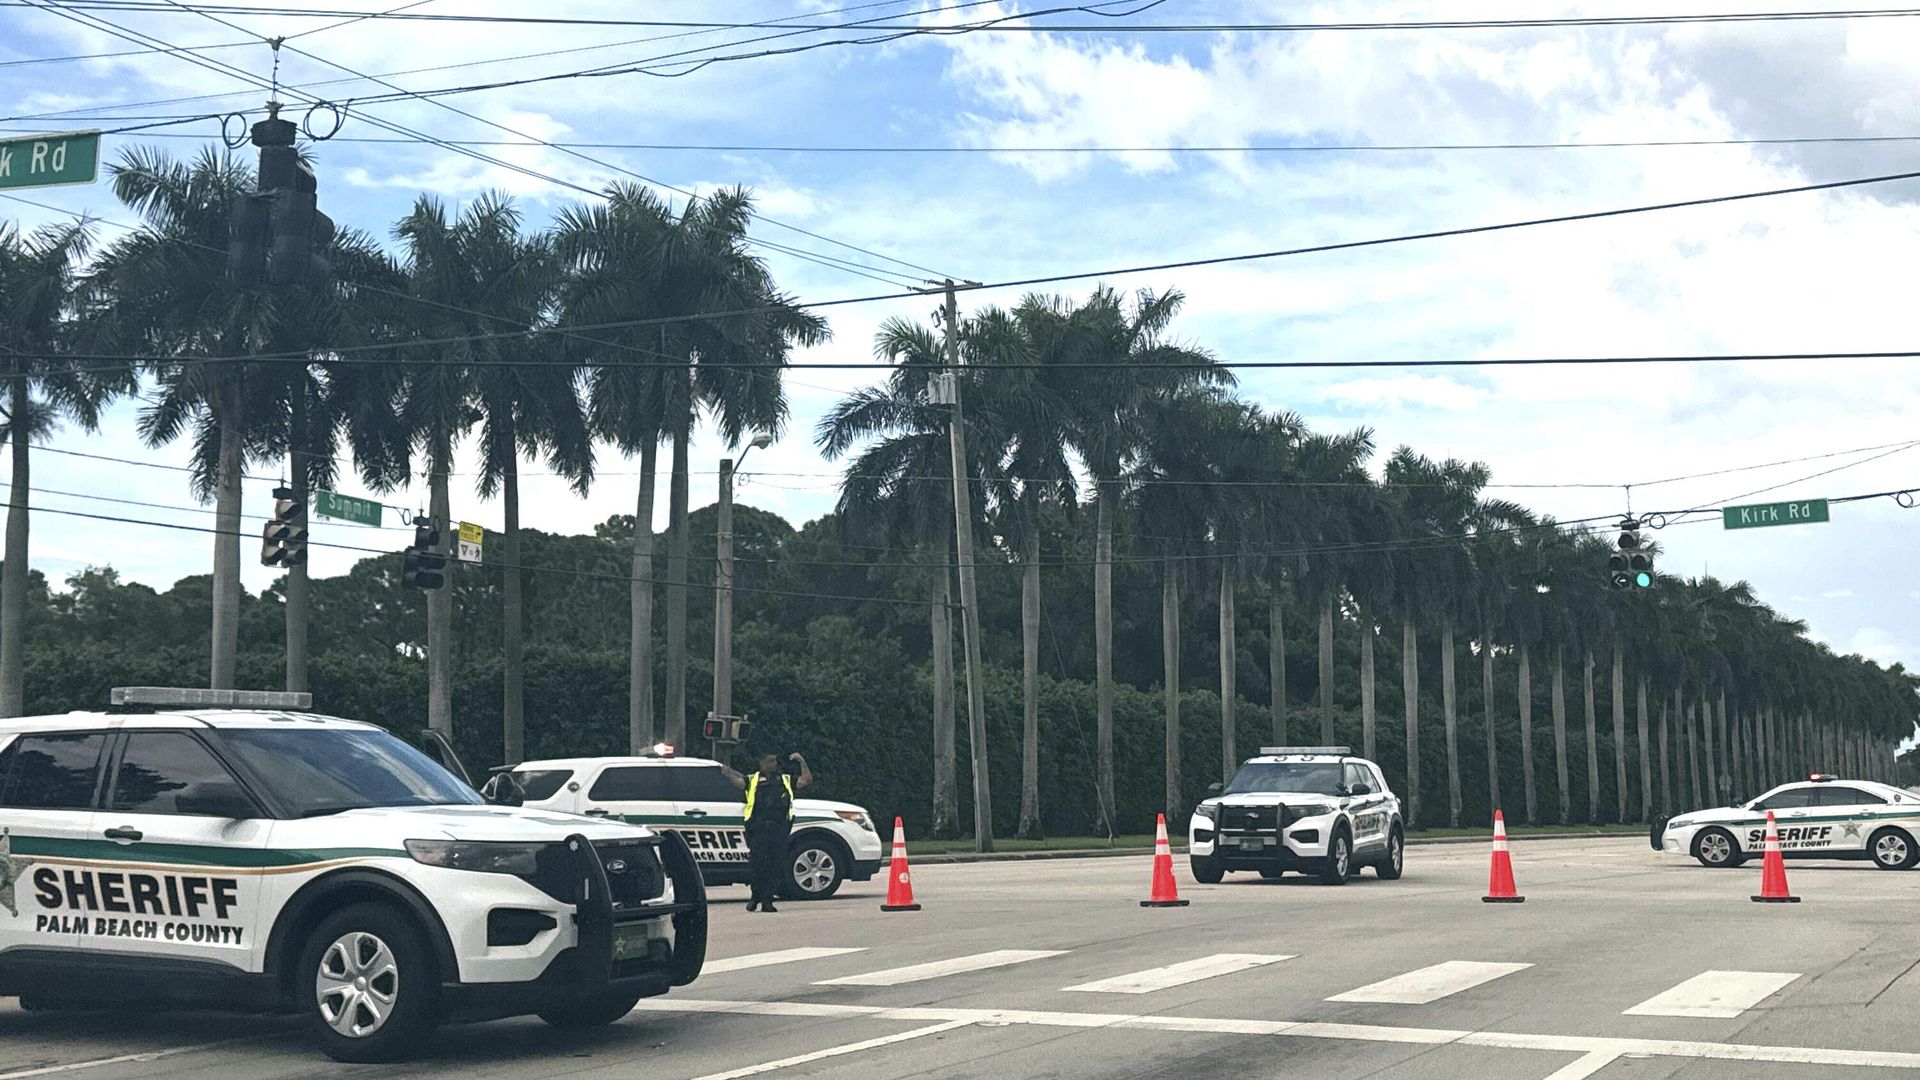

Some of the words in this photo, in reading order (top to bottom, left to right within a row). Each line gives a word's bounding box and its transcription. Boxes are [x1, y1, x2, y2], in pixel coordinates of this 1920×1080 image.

[31, 141, 67, 174] Rd
[328, 494, 371, 517] Summit
[1741, 507, 1779, 524] Kirk
[1789, 503, 1810, 519] Rd
[680, 831, 748, 849] ERIF
[1800, 840, 1832, 848] COUNTY
[693, 851, 715, 861] ACH
[718, 851, 751, 861] COUN
[33, 868, 238, 919] SHERIFF
[36, 914, 89, 936] PALM
[95, 917, 158, 940] BEACH
[164, 922, 244, 945] COUNTY
